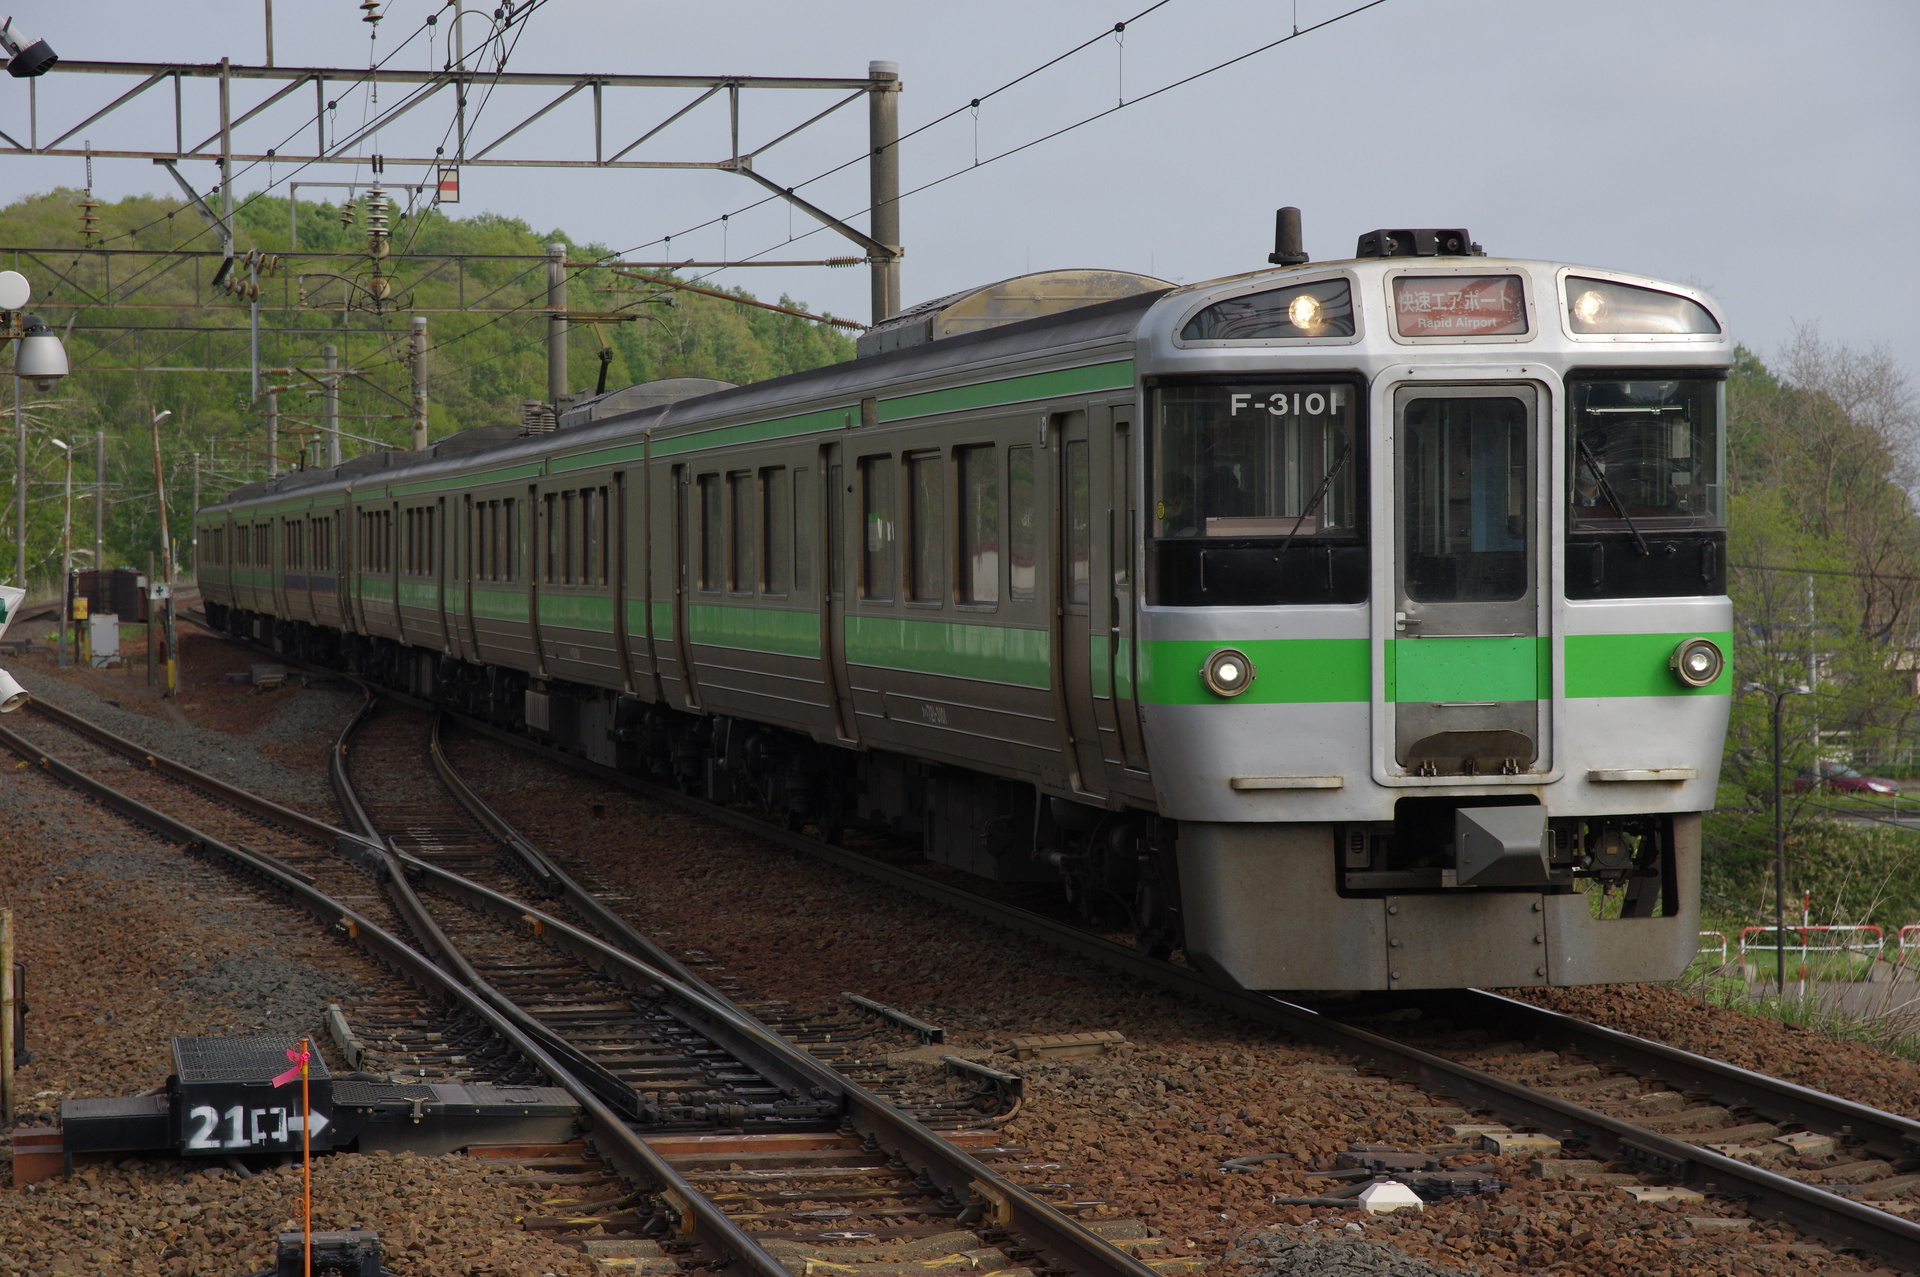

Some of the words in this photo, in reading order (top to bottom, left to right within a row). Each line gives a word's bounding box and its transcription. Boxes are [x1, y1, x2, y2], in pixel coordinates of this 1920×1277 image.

[1398, 289, 1514, 313] 快速エアポート
[1418, 318, 1452, 329] Rapid
[1456, 317, 1497, 329] Airport
[1231, 392, 1337, 416] F-3101
